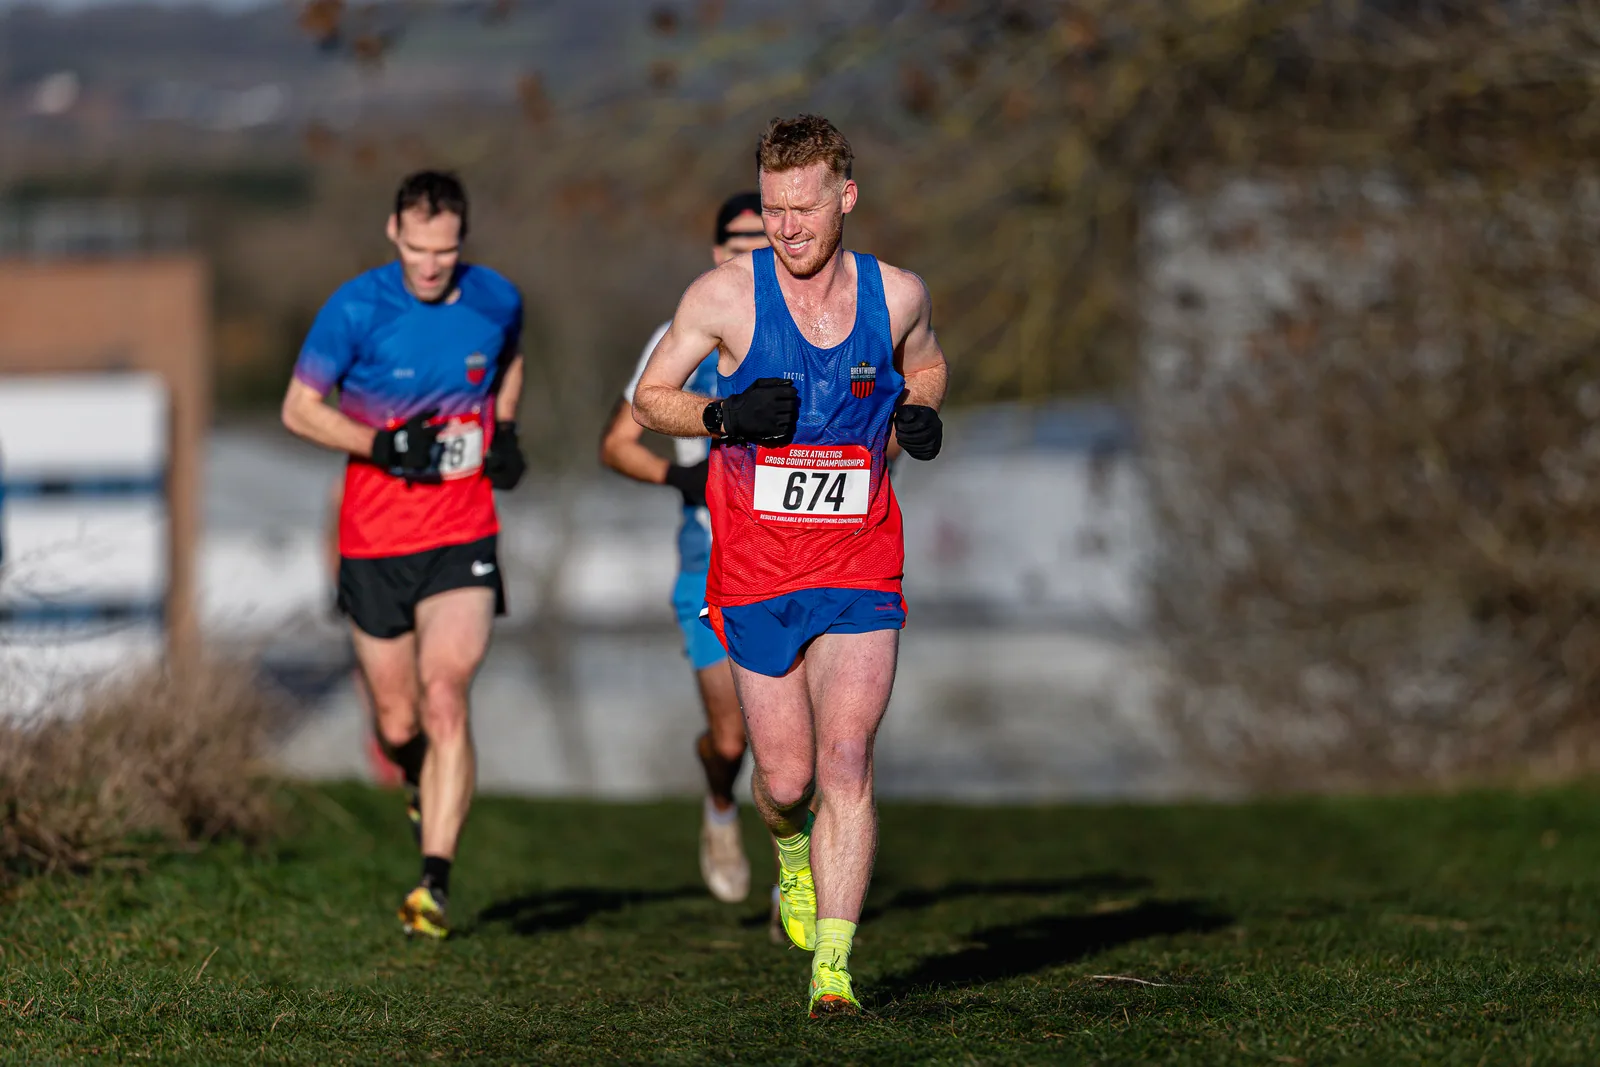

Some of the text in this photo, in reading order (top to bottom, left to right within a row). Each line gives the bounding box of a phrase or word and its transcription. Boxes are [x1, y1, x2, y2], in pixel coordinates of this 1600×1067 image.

[850, 366, 877, 375] BRENTWOOD
[783, 371, 805, 382] TACTIC
[789, 449, 843, 459] ESSEX ATHLETICS
[764, 455, 865, 467] CROSS COUNTRY CHAMPIONSHIPS
[782, 471, 847, 512] 674
[760, 513, 777, 521] RESULTS
[777, 515, 797, 523] AVAILABLE
